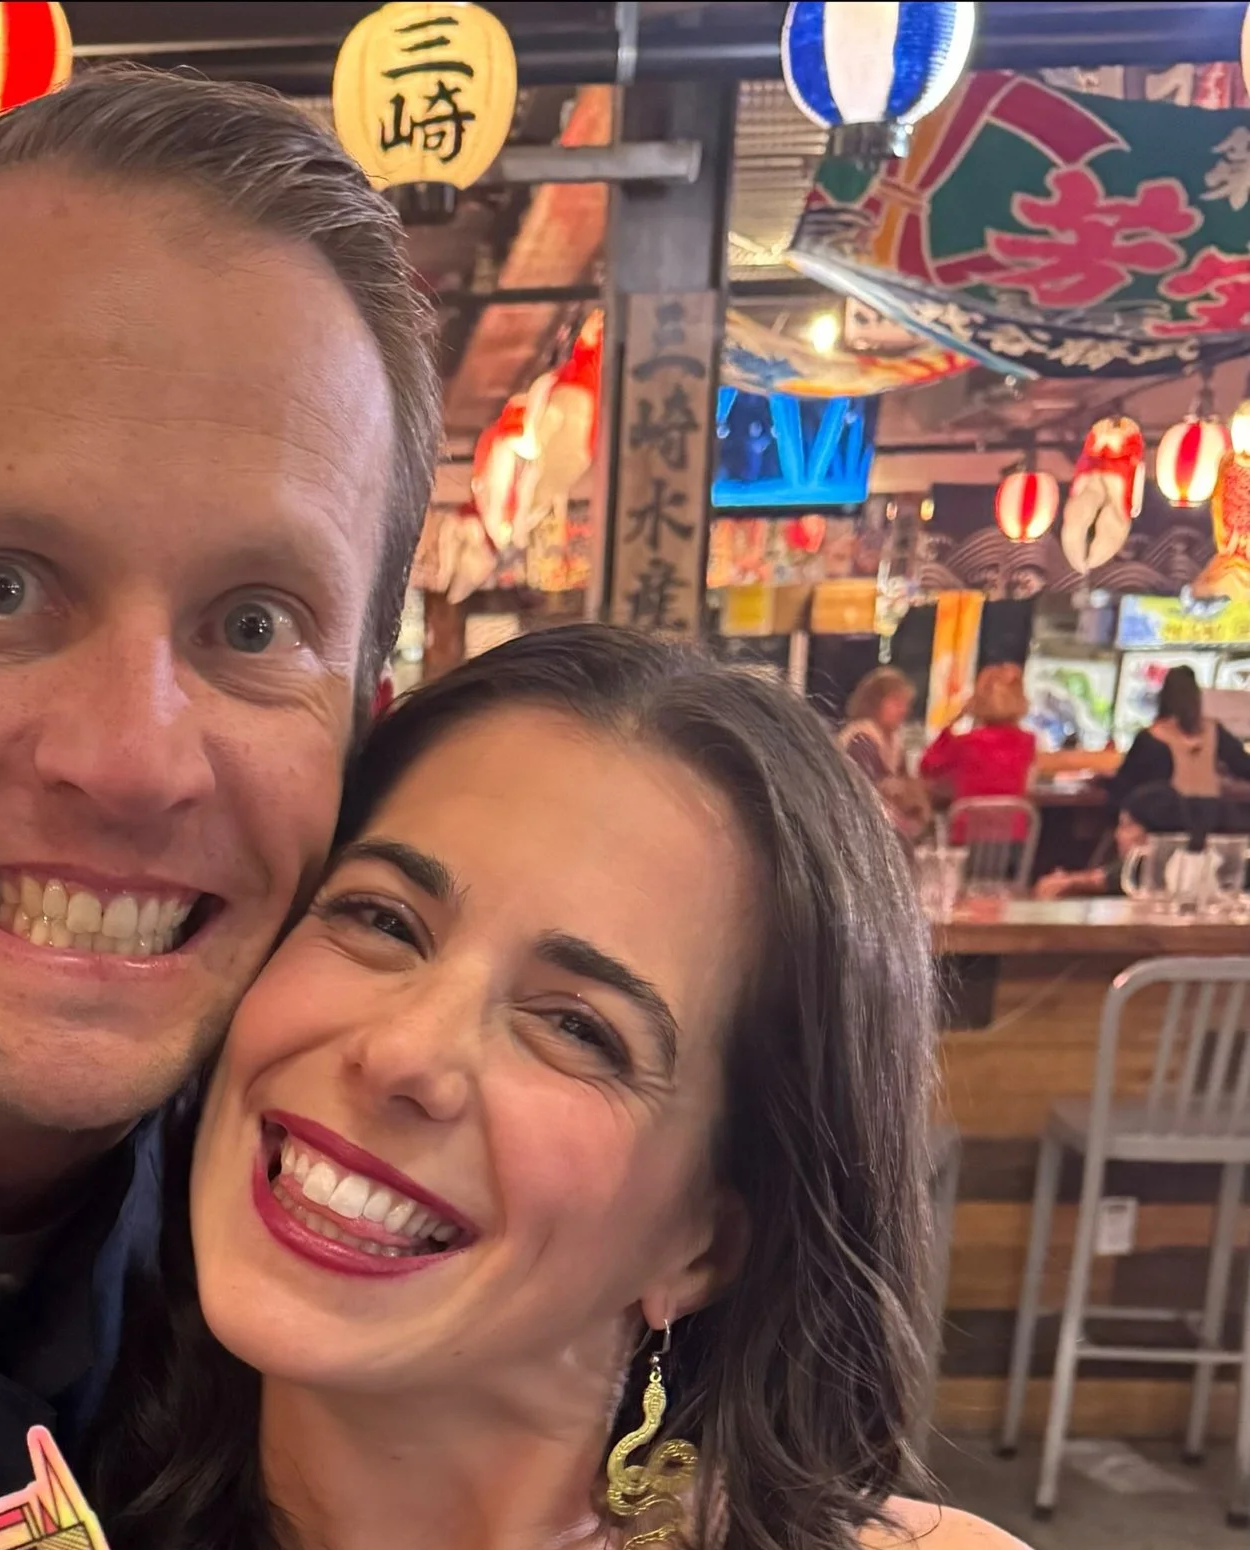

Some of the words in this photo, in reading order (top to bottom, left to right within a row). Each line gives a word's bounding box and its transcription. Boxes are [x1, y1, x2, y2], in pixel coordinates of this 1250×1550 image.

[380, 16, 476, 165] 三崎
[623, 302, 706, 632] 三崎水産
